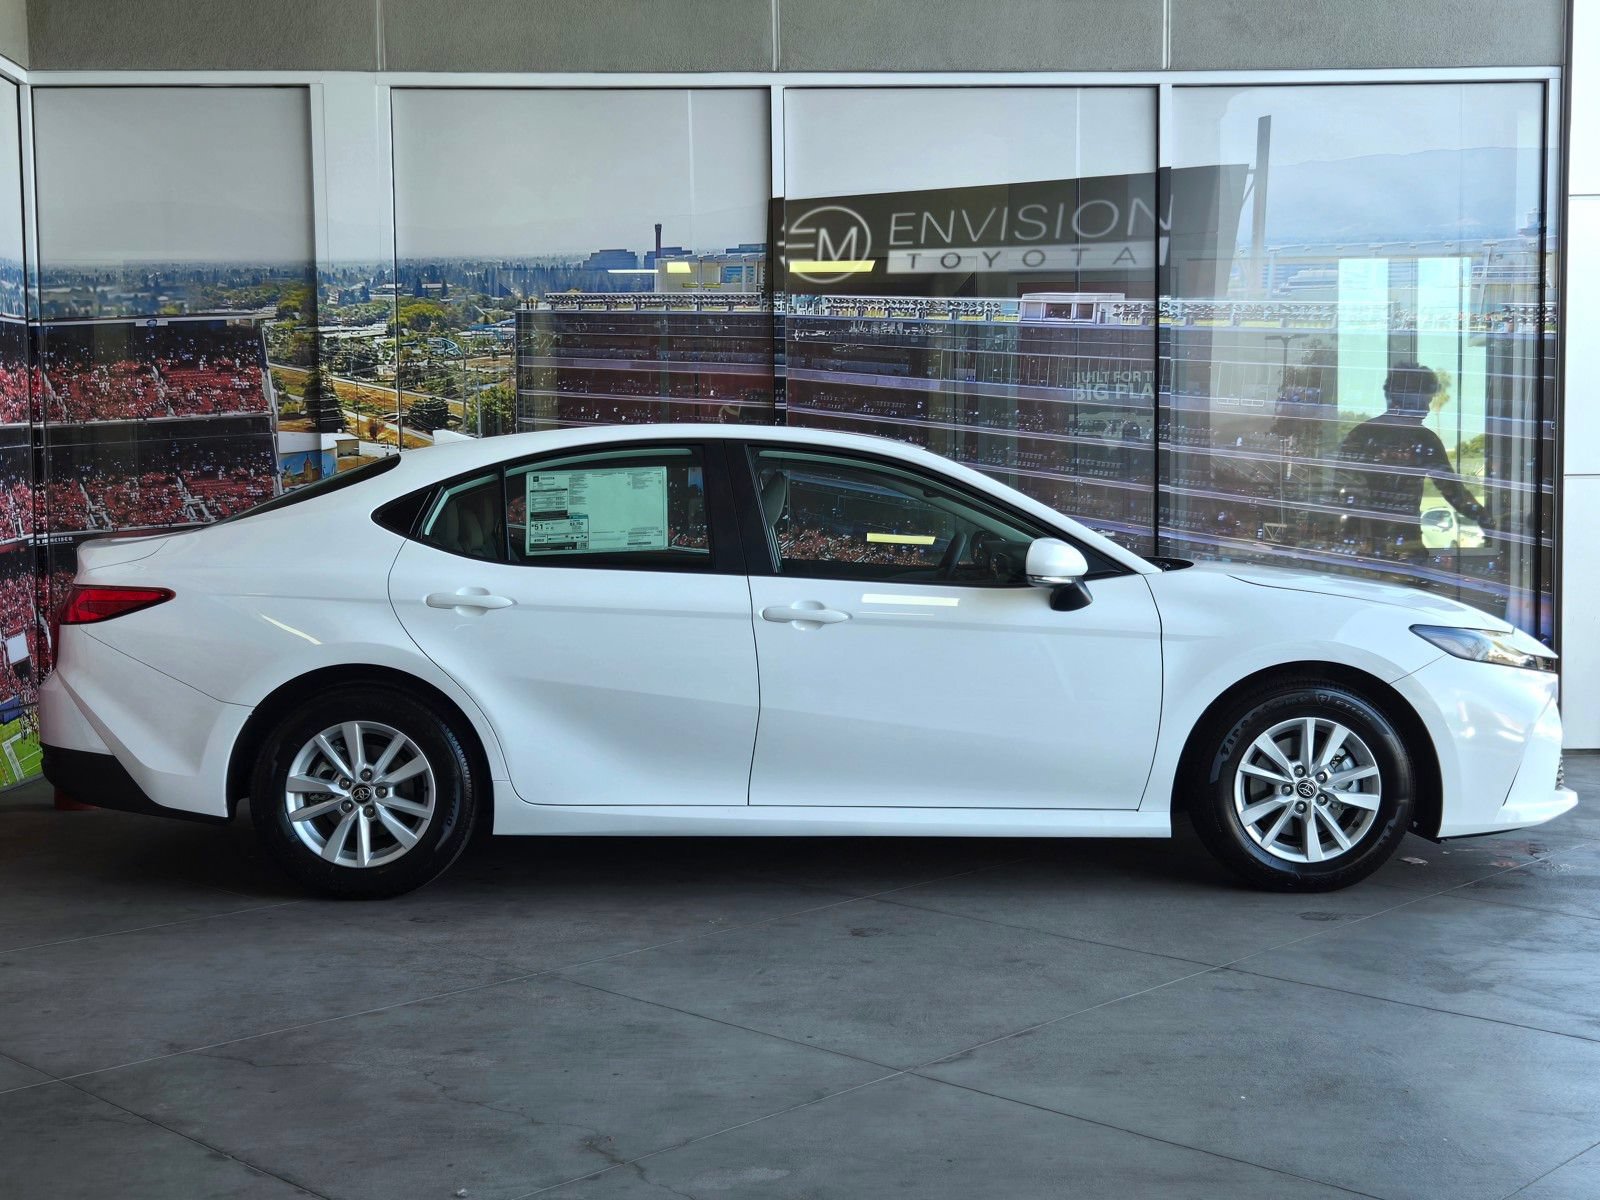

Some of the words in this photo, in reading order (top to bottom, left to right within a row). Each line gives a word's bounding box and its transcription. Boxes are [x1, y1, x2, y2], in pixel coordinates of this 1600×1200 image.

[889, 194, 1174, 246] ENVISION
[906, 245, 1138, 270] TOYOTA
[1072, 370, 1110, 383] BUILT
[1113, 370, 1142, 383] FOR
[1072, 383, 1110, 400] BIG
